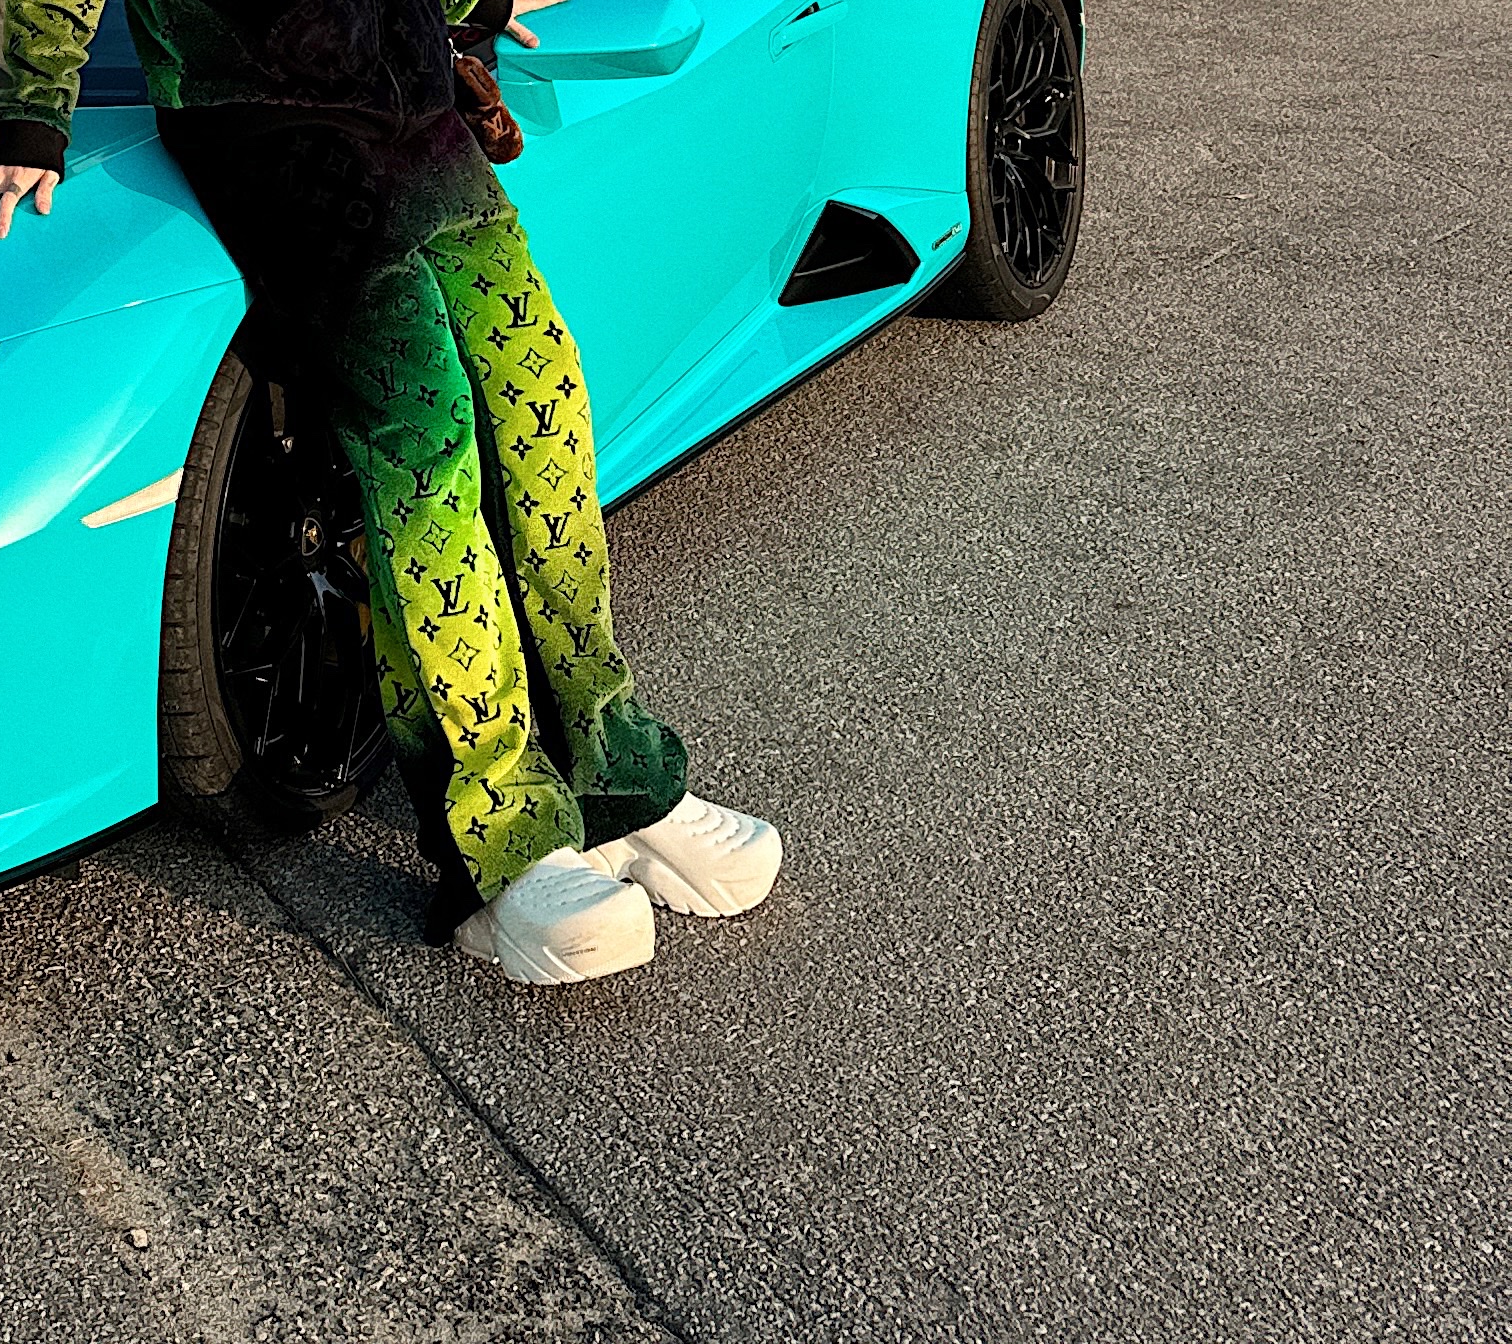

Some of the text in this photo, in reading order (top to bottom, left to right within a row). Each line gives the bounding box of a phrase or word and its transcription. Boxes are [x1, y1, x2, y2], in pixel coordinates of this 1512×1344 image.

[481, 110, 510, 140] LV
[497, 291, 539, 329] LV
[363, 362, 407, 404] LV
[525, 399, 562, 438] LV
[410, 464, 444, 500] LV
[540, 512, 572, 551] LV
[430, 574, 470, 618] LV
[561, 622, 598, 658] LV
[459, 692, 501, 726] LV
